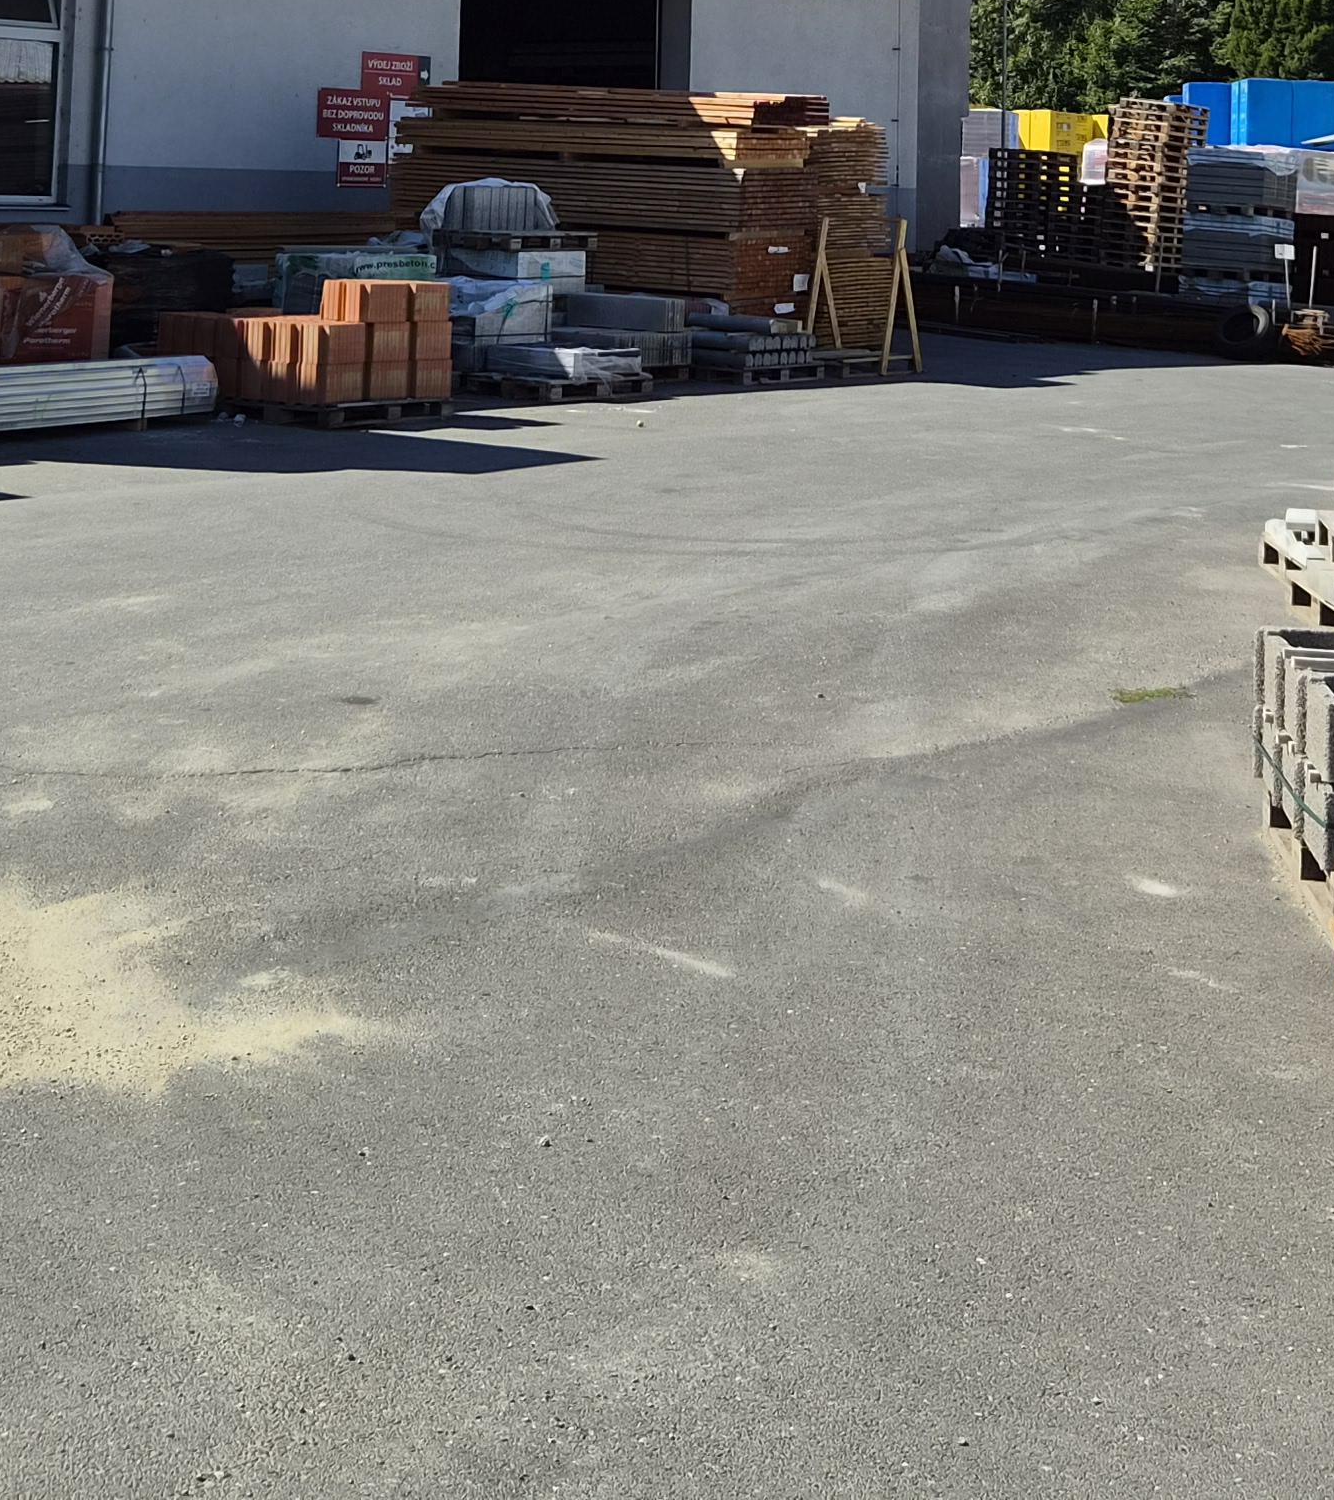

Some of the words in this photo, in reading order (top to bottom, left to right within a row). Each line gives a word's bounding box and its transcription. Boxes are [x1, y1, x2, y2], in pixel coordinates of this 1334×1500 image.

[378, 76, 402, 86] SKLAD
[327, 95, 352, 106] ZÁKAZ
[353, 98, 381, 108] VSTUPU
[323, 109, 337, 118] BEZ
[338, 109, 384, 121] DOPROVODU
[332, 121, 374, 133] SKLADNÍKA
[349, 164, 375, 174] POZOR
